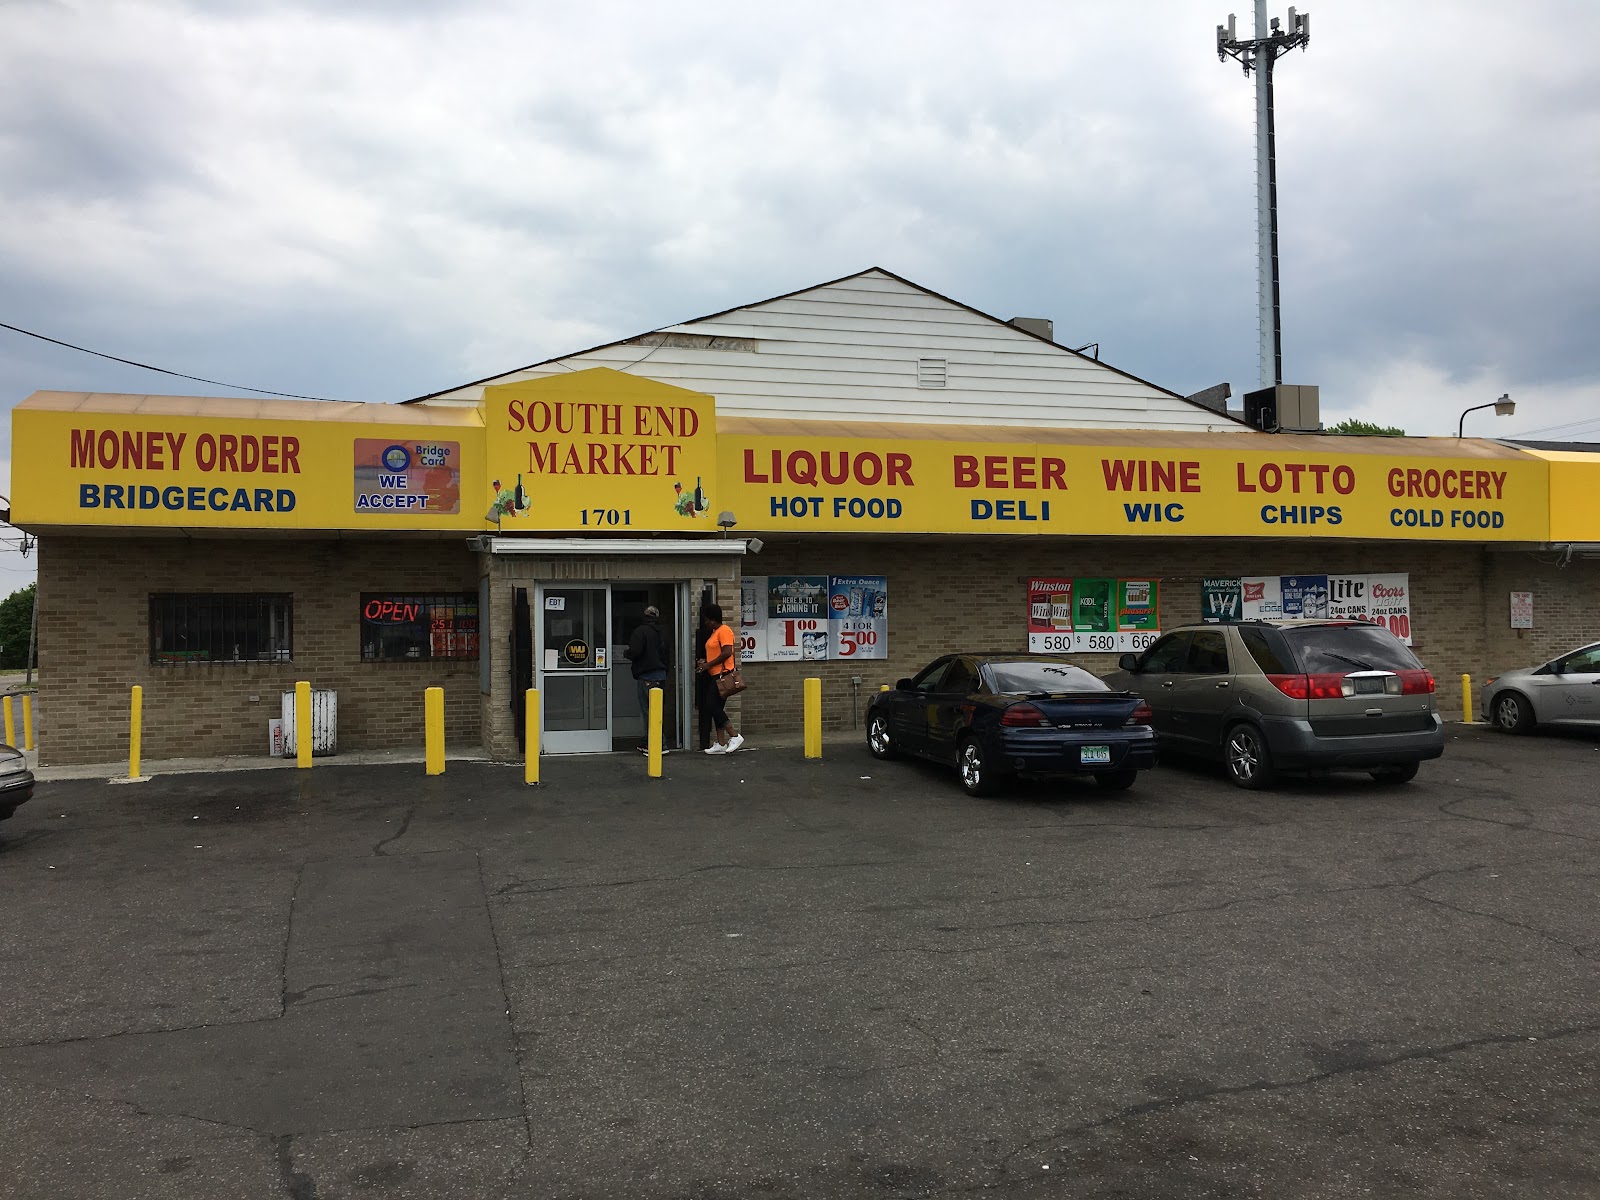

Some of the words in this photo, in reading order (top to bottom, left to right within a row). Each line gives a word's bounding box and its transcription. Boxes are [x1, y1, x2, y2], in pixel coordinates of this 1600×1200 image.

[508, 399, 624, 435] SOUTH
[633, 405, 699, 438] END
[70, 428, 187, 470] MONEY
[195, 432, 301, 474] ORDER
[416, 445, 450, 457] Bridge
[421, 457, 446, 466] Card
[527, 441, 682, 476] MARKET
[379, 474, 408, 489] WE
[744, 449, 915, 488] LIQUOR
[954, 455, 1068, 490] BEER
[1101, 459, 1202, 493] WINE
[1237, 462, 1356, 495] LOTTO
[1387, 467, 1507, 500] GROCERY
[79, 483, 296, 513] BRIDGECARD
[356, 494, 430, 509] ACCEPT
[580, 508, 632, 526] 1701
[770, 496, 823, 518] HOT
[833, 497, 902, 519] FOOD
[971, 499, 1050, 521] DELI
[1123, 503, 1185, 523] WIC
[1260, 505, 1343, 525] CHIPS
[1390, 508, 1444, 528] COLD
[1451, 510, 1504, 529] FOOD
[1031, 580, 1071, 592] Winston
[1328, 579, 1364, 603] Lite
[1372, 583, 1405, 598] Coors
[549, 598, 561, 606] EBT
[1080, 597, 1097, 606] KOOL
[1375, 597, 1404, 606] LIGHT
[365, 600, 419, 622] OPEN
[776, 604, 808, 614] EARNING
[811, 604, 819, 614] IT
[1120, 608, 1155, 616] pleasure!
[1347, 605, 1366, 614] CANS
[1388, 607, 1407, 615] CANS
[853, 622, 872, 630] FOR
[1044, 636, 1071, 650] 5.80
[1089, 636, 1114, 650] 5.80
